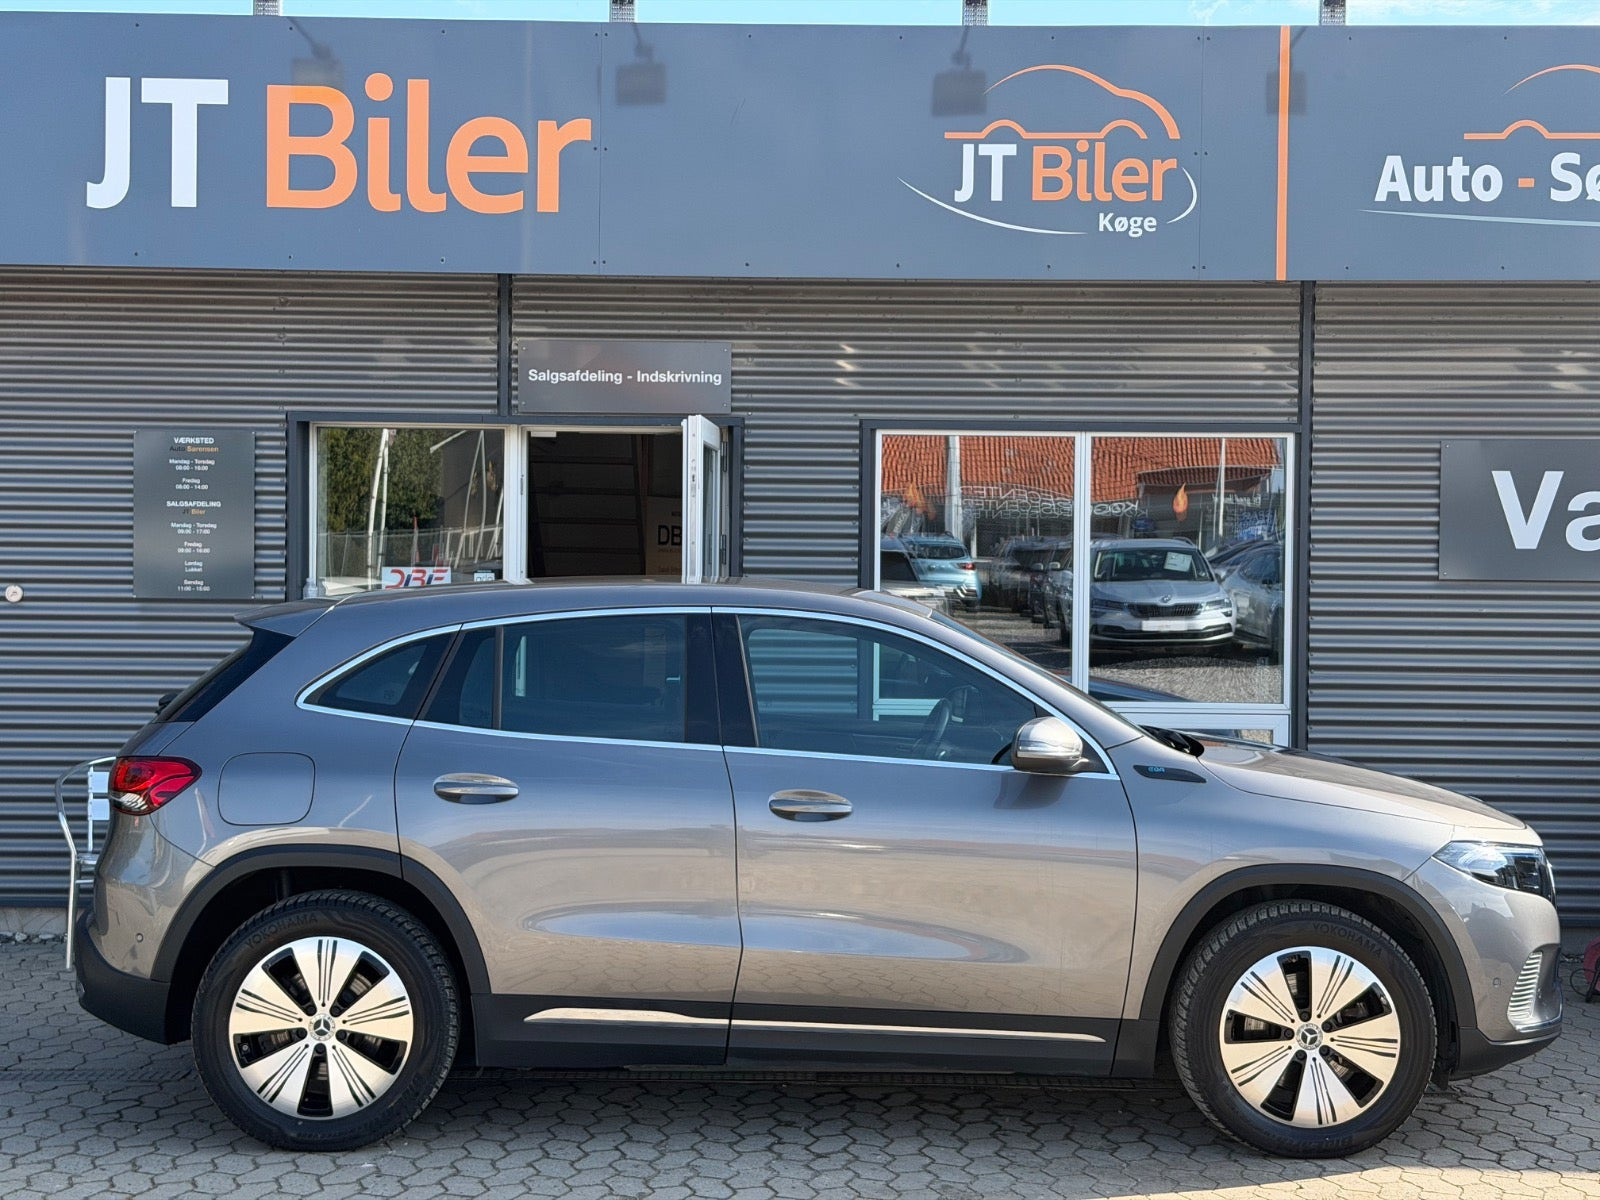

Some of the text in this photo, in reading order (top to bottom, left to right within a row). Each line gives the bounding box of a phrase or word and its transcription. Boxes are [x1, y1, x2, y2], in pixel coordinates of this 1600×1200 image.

[86, 73, 592, 214] JT Biler
[953, 139, 1178, 204] JT Biler
[1374, 155, 1503, 203] Auto
[1098, 212, 1157, 238] Køge
[528, 368, 623, 385] Salgsafdeling
[636, 370, 722, 386] Indskrivning
[1491, 470, 1600, 552] Va
